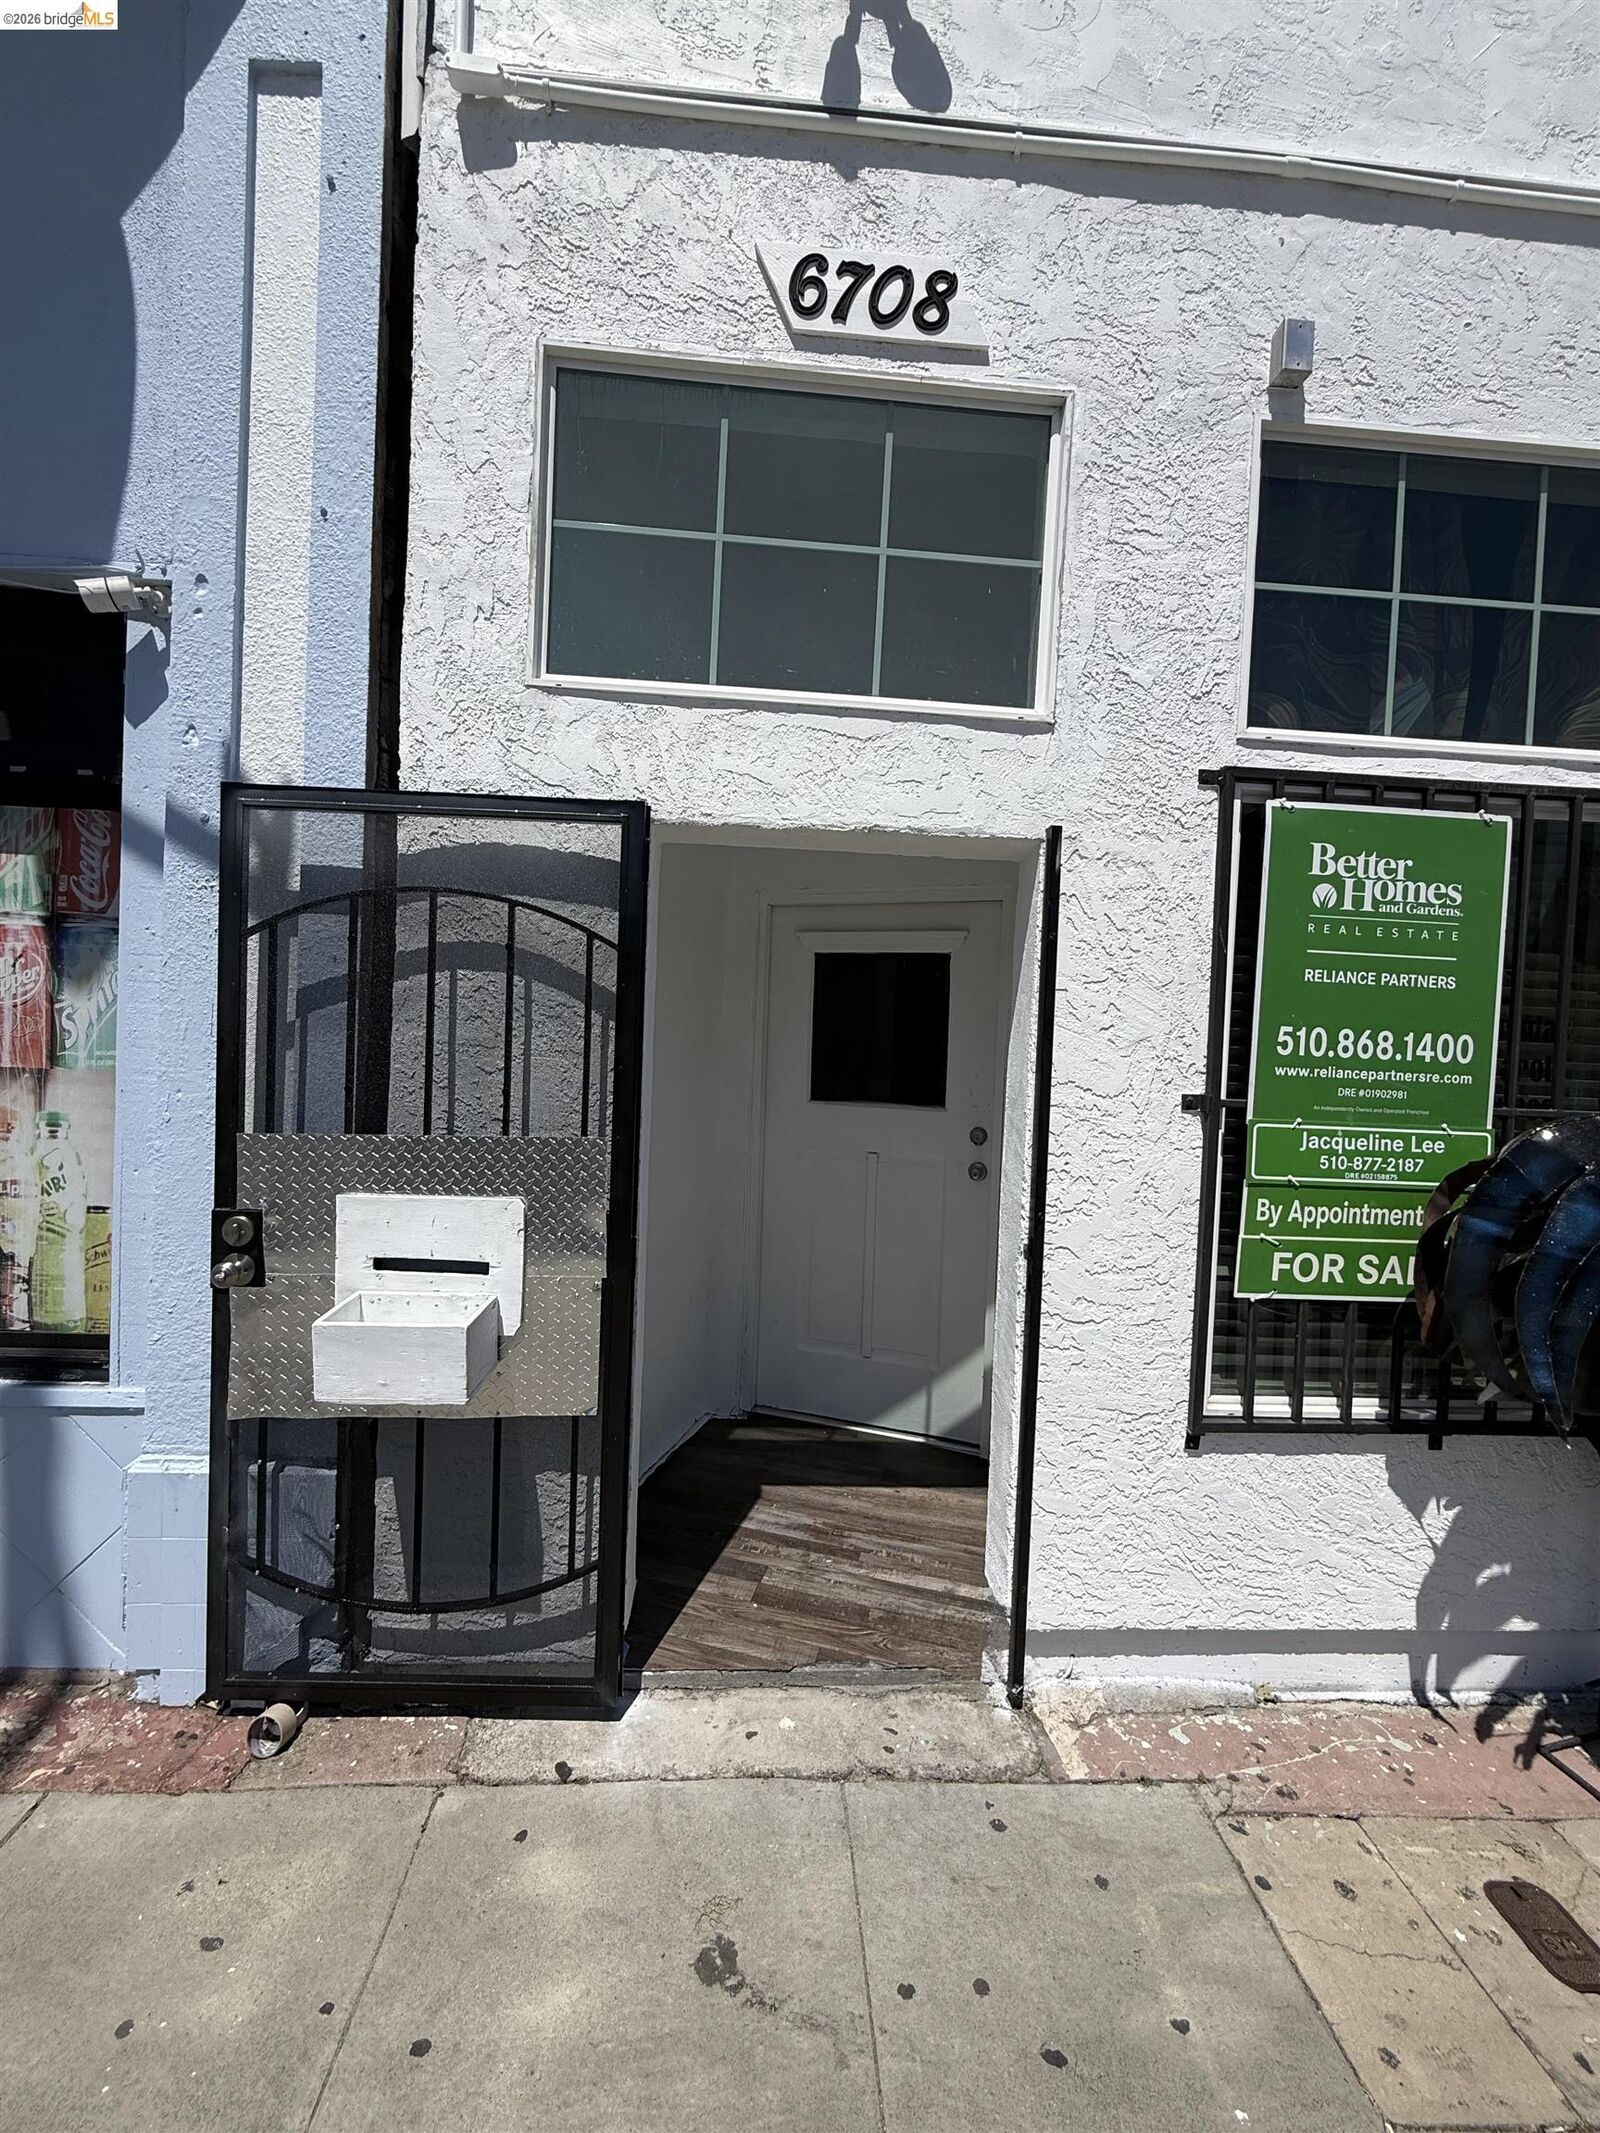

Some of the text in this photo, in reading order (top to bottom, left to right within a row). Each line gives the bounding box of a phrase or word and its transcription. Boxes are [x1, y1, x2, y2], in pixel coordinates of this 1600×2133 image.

[788, 252, 959, 336] 6708
[1308, 841, 1413, 881] Better
[1339, 877, 1463, 912] Homes
[1378, 902, 1404, 914] and
[1308, 923, 1459, 941] REAL ESTATE
[1304, 968, 1457, 989] RELIANCE PARTNERS
[1276, 1025, 1474, 1065] 510.868.1400
[1275, 1065, 1473, 1085] www.reliancepartnersre.com
[1337, 1088, 1408, 1100] DRE #01902981
[1299, 1131, 1446, 1154] Jacqueline Lee
[1319, 1155, 1424, 1173] 510-877-2187
[1344, 1172, 1360, 1180] DRE
[1255, 1198, 1425, 1230] By Appointment
[1271, 1251, 1346, 1284] FOR
